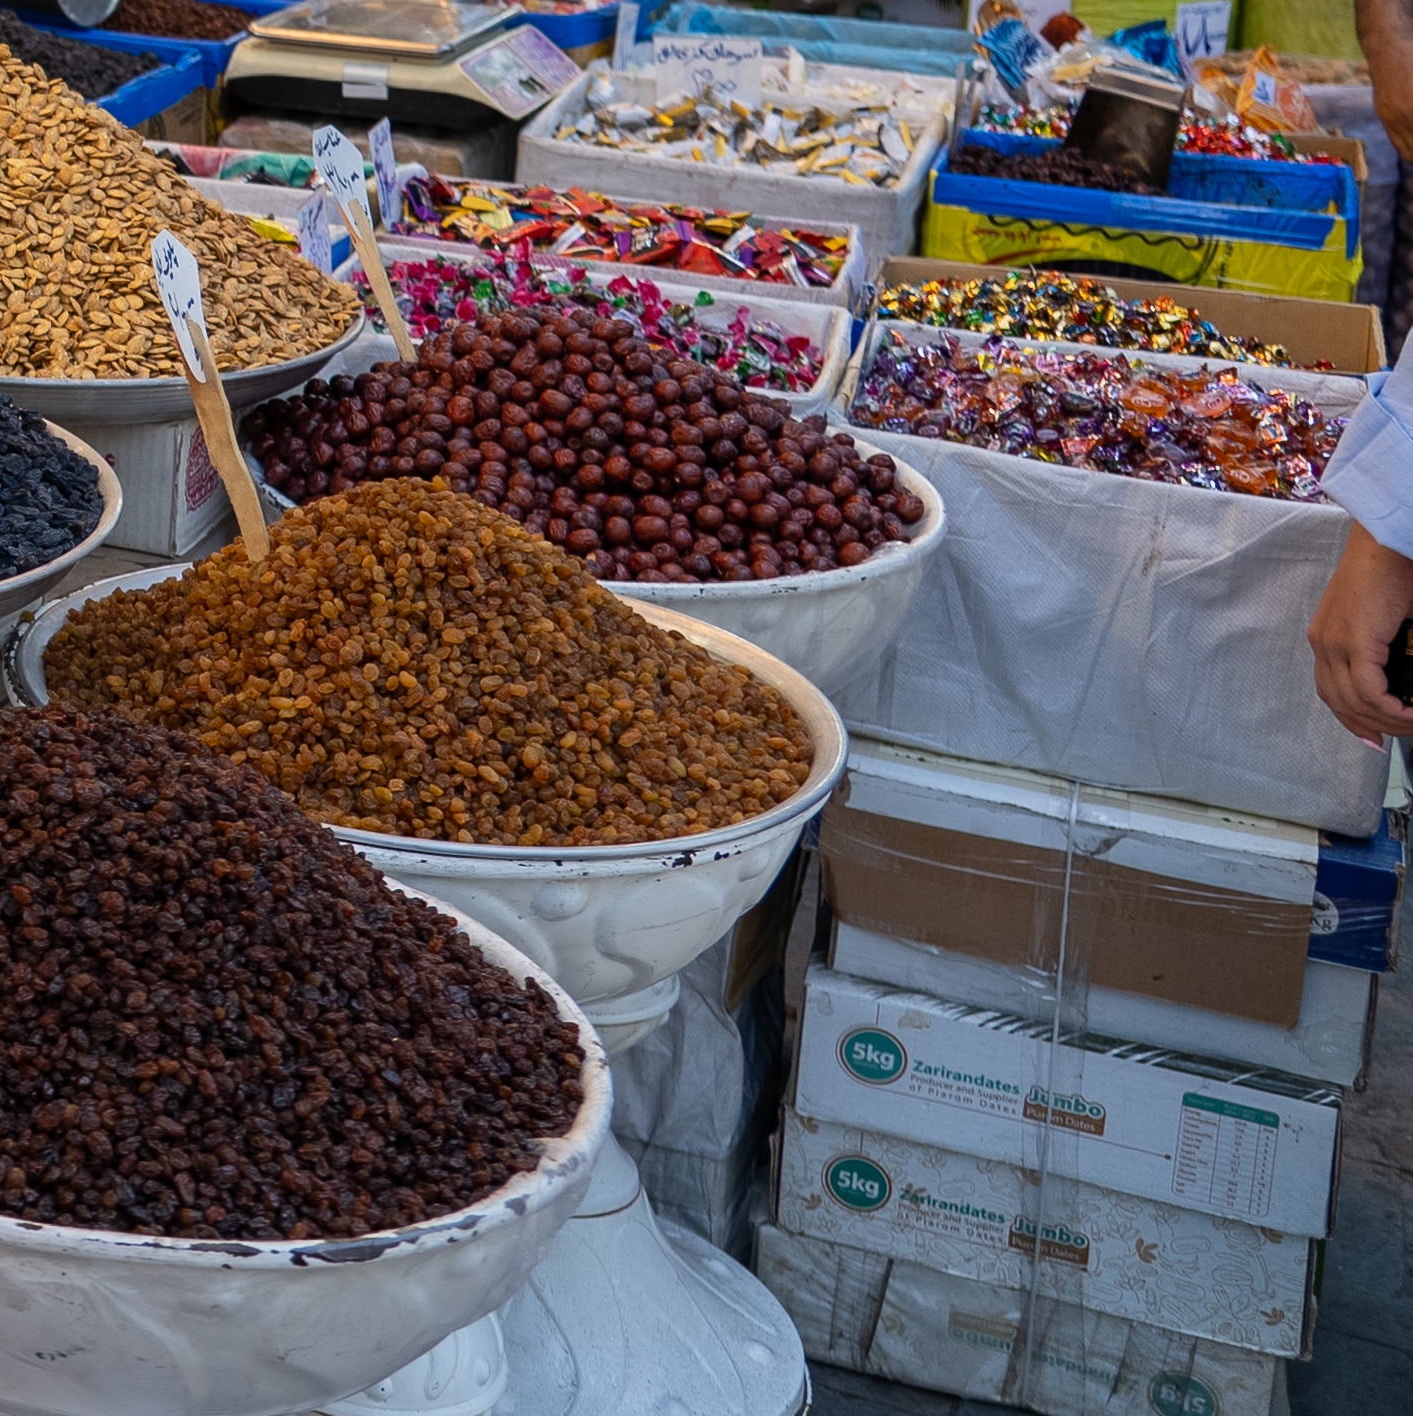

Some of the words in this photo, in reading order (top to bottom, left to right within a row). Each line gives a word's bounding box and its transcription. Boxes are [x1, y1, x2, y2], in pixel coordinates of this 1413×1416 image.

[852, 1041, 895, 1071] 5kg
[913, 1060, 1021, 1096] Zarirandates
[956, 1084, 975, 1096] and
[977, 1088, 1018, 1106] Supplier
[979, 1099, 1017, 1115] Dates
[1028, 1086, 1103, 1118] Jumbo
[1065, 1115, 1095, 1132] Dates
[837, 1170, 879, 1199] 5kg
[1014, 1215, 1086, 1247] Jumbo
